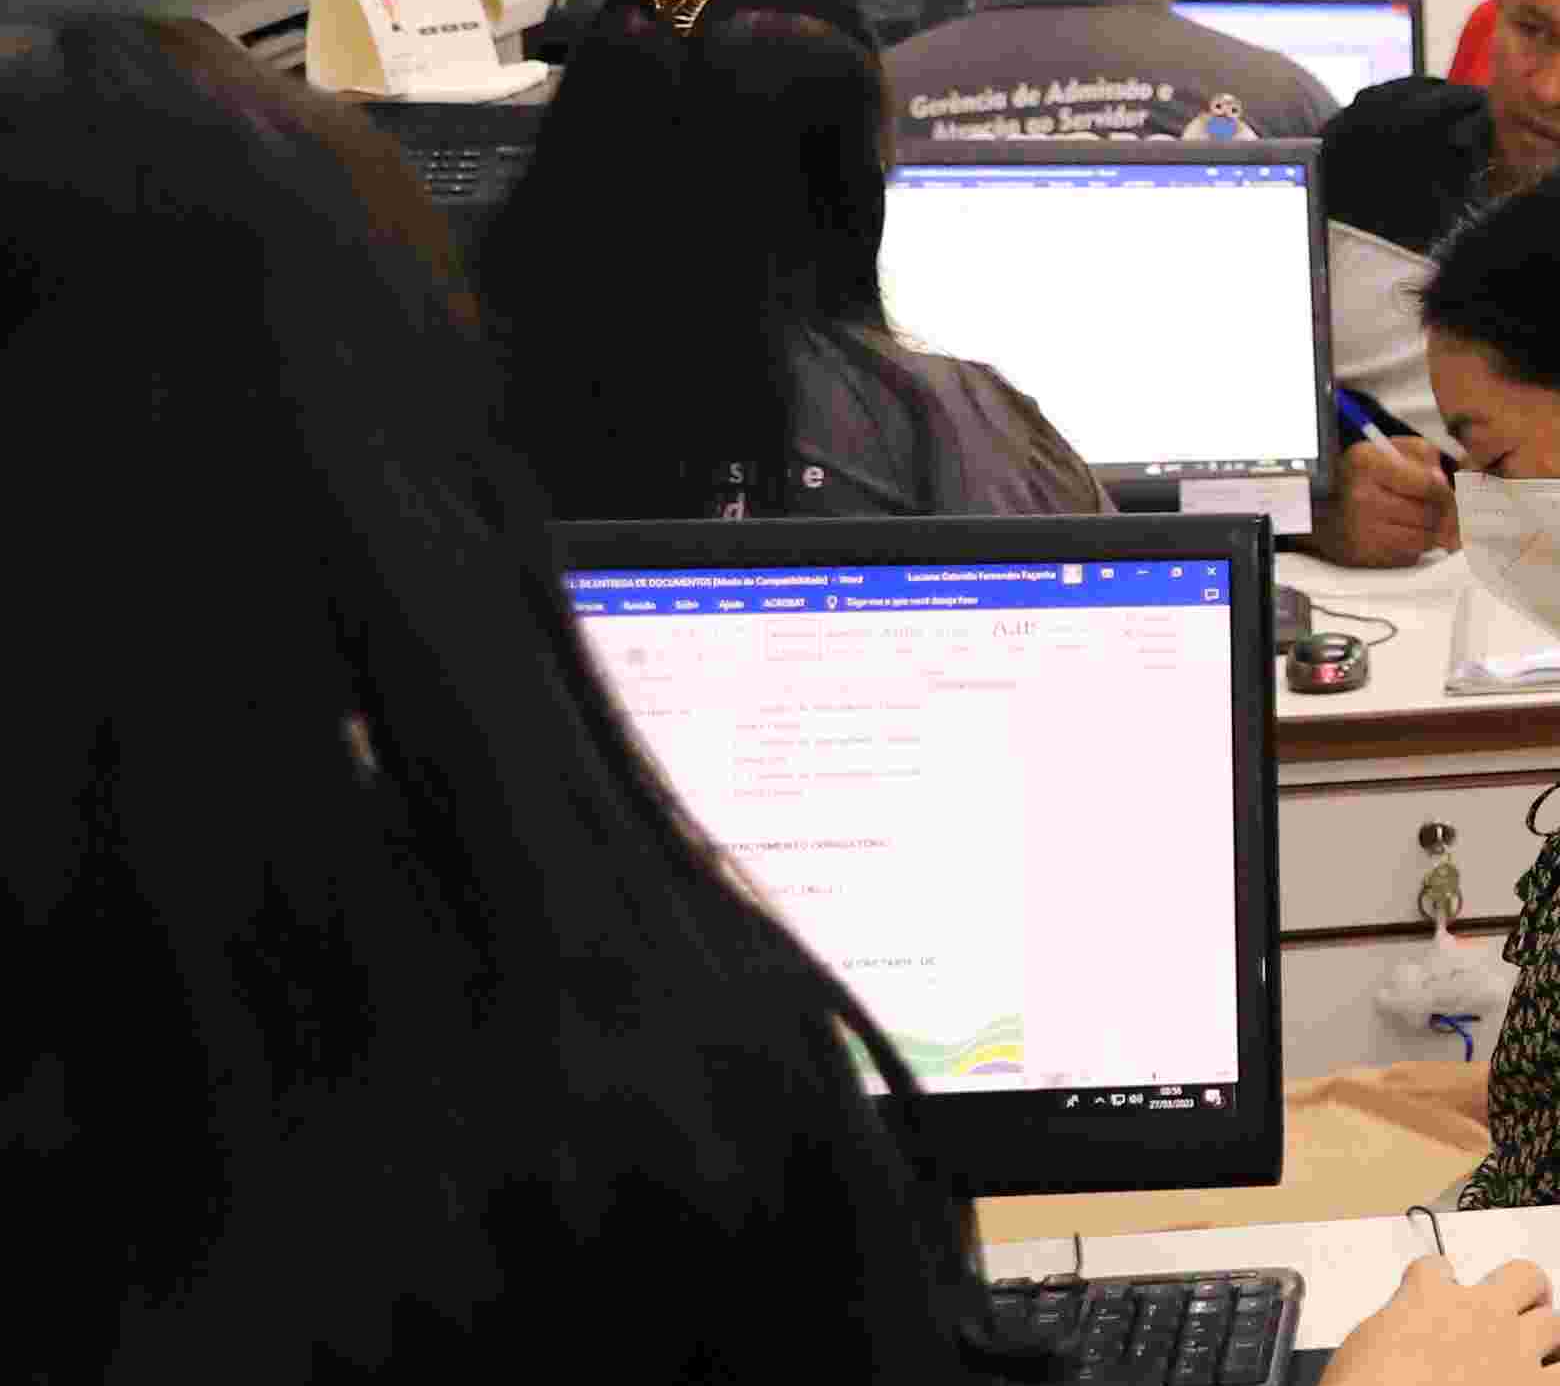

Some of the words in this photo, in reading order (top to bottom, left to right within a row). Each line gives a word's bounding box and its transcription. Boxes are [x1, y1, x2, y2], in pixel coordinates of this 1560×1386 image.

[909, 87, 1008, 119] Gerência
[1011, 82, 1042, 109] de
[1044, 76, 1154, 107] Admissão
[1156, 83, 1174, 103] e
[1057, 105, 1150, 134] Servidor
